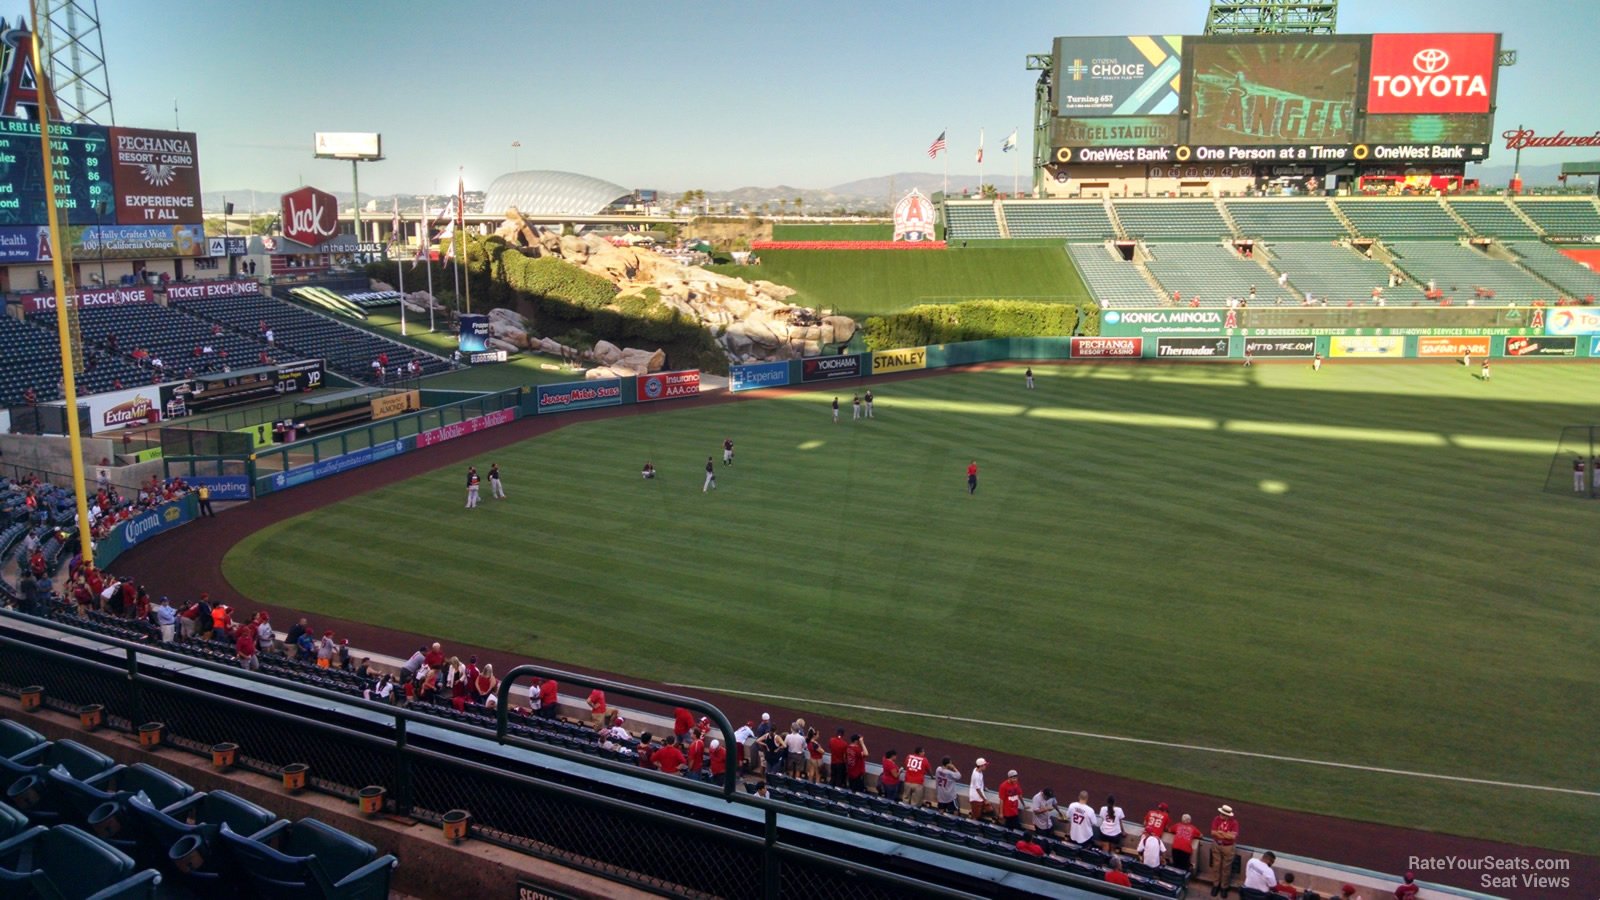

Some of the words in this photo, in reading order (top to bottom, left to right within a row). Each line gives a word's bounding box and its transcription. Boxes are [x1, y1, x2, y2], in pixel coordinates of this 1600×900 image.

[1091, 64, 1145, 76] CHOICE
[1372, 75, 1488, 97] TOYOTA
[1066, 95, 1099, 104] Turning
[8, 122, 28, 132] RBI
[30, 123, 73, 135] LEDERS
[1066, 126, 1108, 140] ANGEL
[1110, 125, 1169, 140] STADIUM
[116, 135, 192, 153] PECHANGA
[1502, 129, 1600, 150] Budwei
[49, 141, 69, 151] MIA
[85, 143, 97, 153] 97
[1196, 146, 1225, 160] One
[1228, 146, 1277, 160] Person
[1279, 147, 1295, 159] at
[1297, 148, 1307, 159] a
[1310, 145, 1345, 159] Time
[1374, 145, 1430, 159] OneWest
[1432, 145, 1463, 159] Bank
[118, 152, 154, 163] RESORT
[160, 154, 193, 165] CASINO
[1080, 147, 1135, 161] OneWest
[1137, 147, 1169, 161] Bank
[50, 156, 70, 165] LAD
[86, 157, 98, 167] 89
[52, 170, 70, 181] ATL
[88, 171, 100, 182] 86
[53, 185, 72, 194] PHI
[89, 186, 101, 195] 80
[55, 199, 77, 209] WSH
[90, 199, 100, 209] 7
[125, 195, 194, 208] EXPERIENCE
[144, 209, 156, 220] IT
[157, 209, 180, 220] ALL
[287, 193, 337, 236] Jack
[120, 229, 147, 240] Crafted
[148, 228, 167, 239] With
[106, 240, 144, 250] California
[145, 241, 174, 251] Oranges
[321, 243, 330, 253] in
[330, 243, 344, 252] the
[344, 243, 359, 252] box
[167, 284, 206, 299] TICKET
[33, 294, 81, 310] TICET
[1121, 312, 1168, 323] KONICA
[1168, 312, 1221, 323] MINOLTA
[1224, 309, 1237, 328] A
[1531, 308, 1544, 328] A
[1433, 328, 1463, 336] SERVICES
[1079, 340, 1135, 349] PECHANGA
[1159, 345, 1215, 356] Thermador
[1246, 343, 1272, 352] NITTO
[1274, 342, 1313, 351] TIRE.COM
[1421, 345, 1457, 354] SAFARI
[1458, 344, 1486, 354] PARK
[818, 357, 857, 370] YOKOHAMA
[873, 351, 925, 369] STANLEY
[307, 371, 321, 384] yp
[666, 374, 700, 384] Insuranc
[746, 368, 784, 384] Experian
[541, 393, 571, 405] Jersey
[597, 387, 620, 397] Subs
[125, 512, 161, 544] Corona
[907, 758, 923, 770] 101
[1073, 813, 1085, 826] 27
